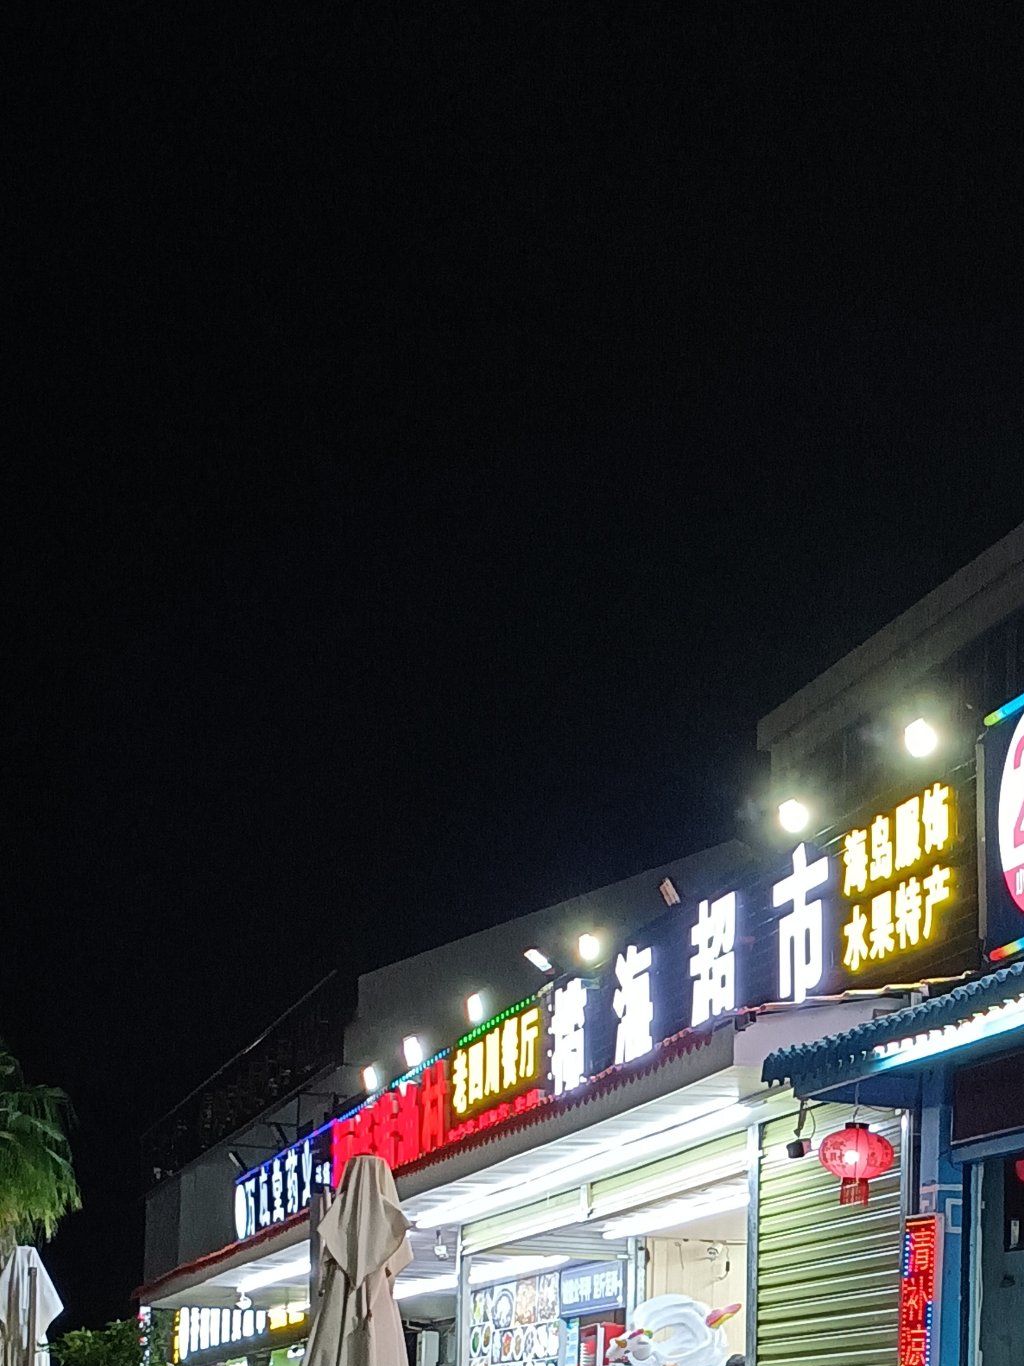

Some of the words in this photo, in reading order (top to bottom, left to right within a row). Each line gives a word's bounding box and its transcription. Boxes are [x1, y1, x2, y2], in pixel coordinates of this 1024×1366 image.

[842, 782, 951, 897] 海岛服饰
[842, 863, 951, 972] 水果特产
